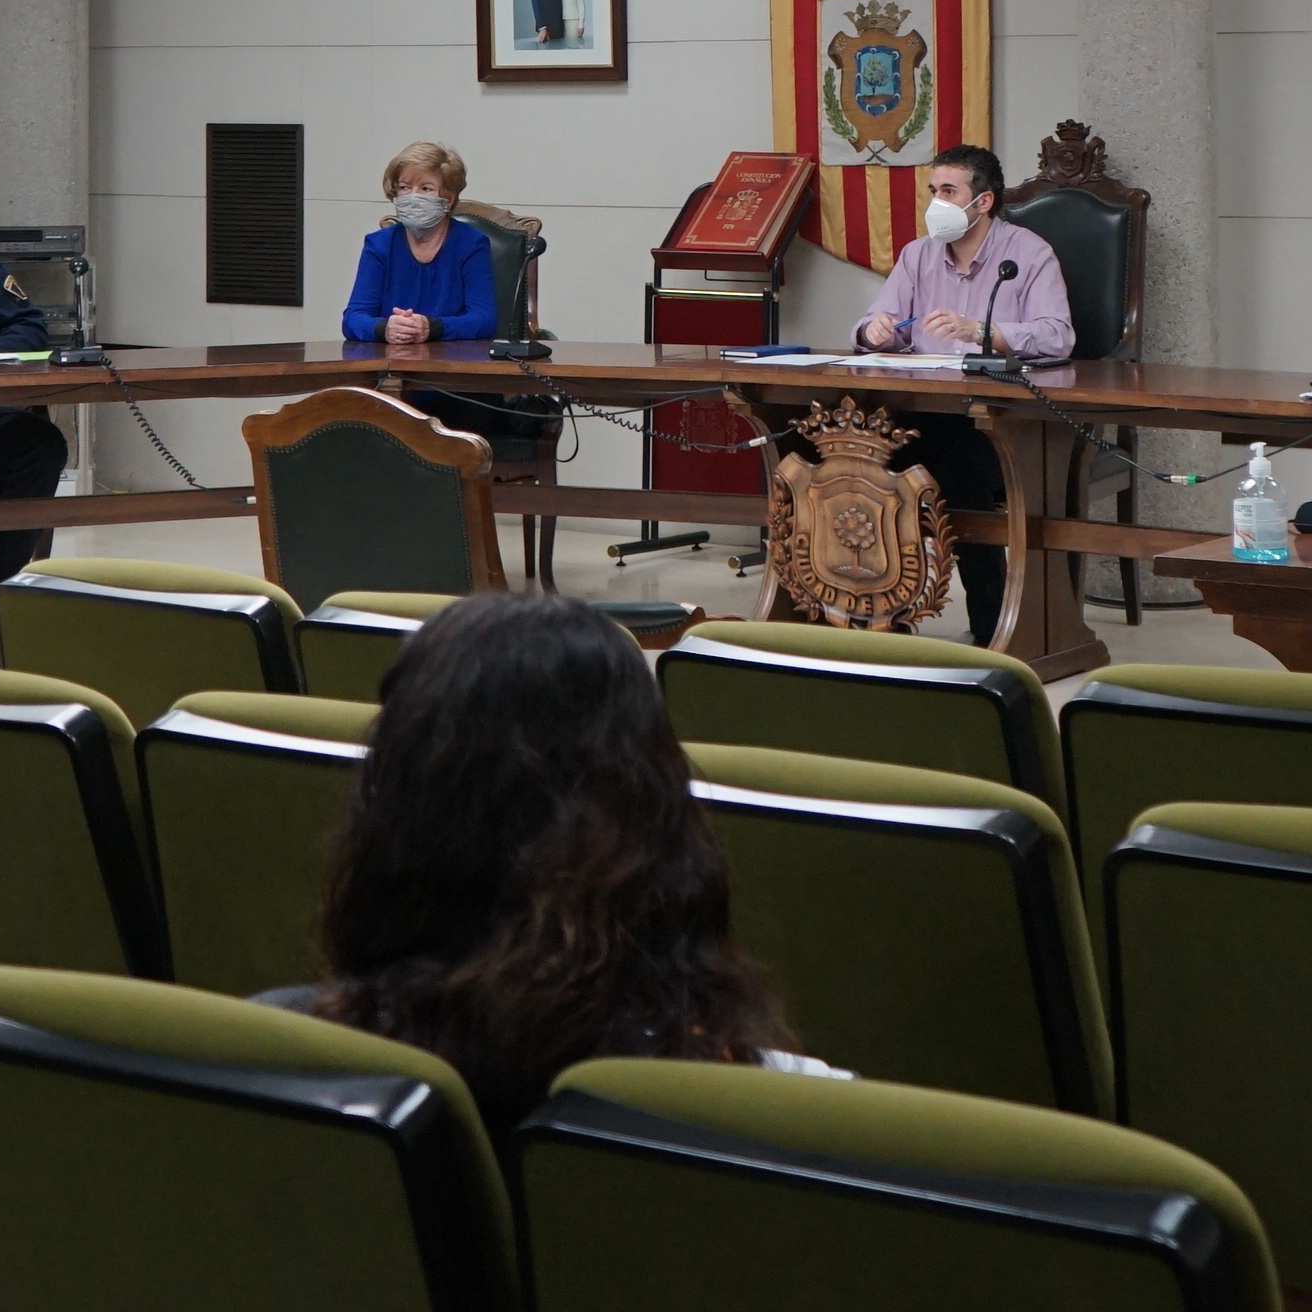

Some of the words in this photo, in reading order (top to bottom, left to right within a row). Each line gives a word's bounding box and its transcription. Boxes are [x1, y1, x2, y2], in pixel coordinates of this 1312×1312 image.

[795, 534, 836, 605] CIUDAD
[846, 595, 872, 614] DE
[881, 544, 919, 611] ALBAIDA
